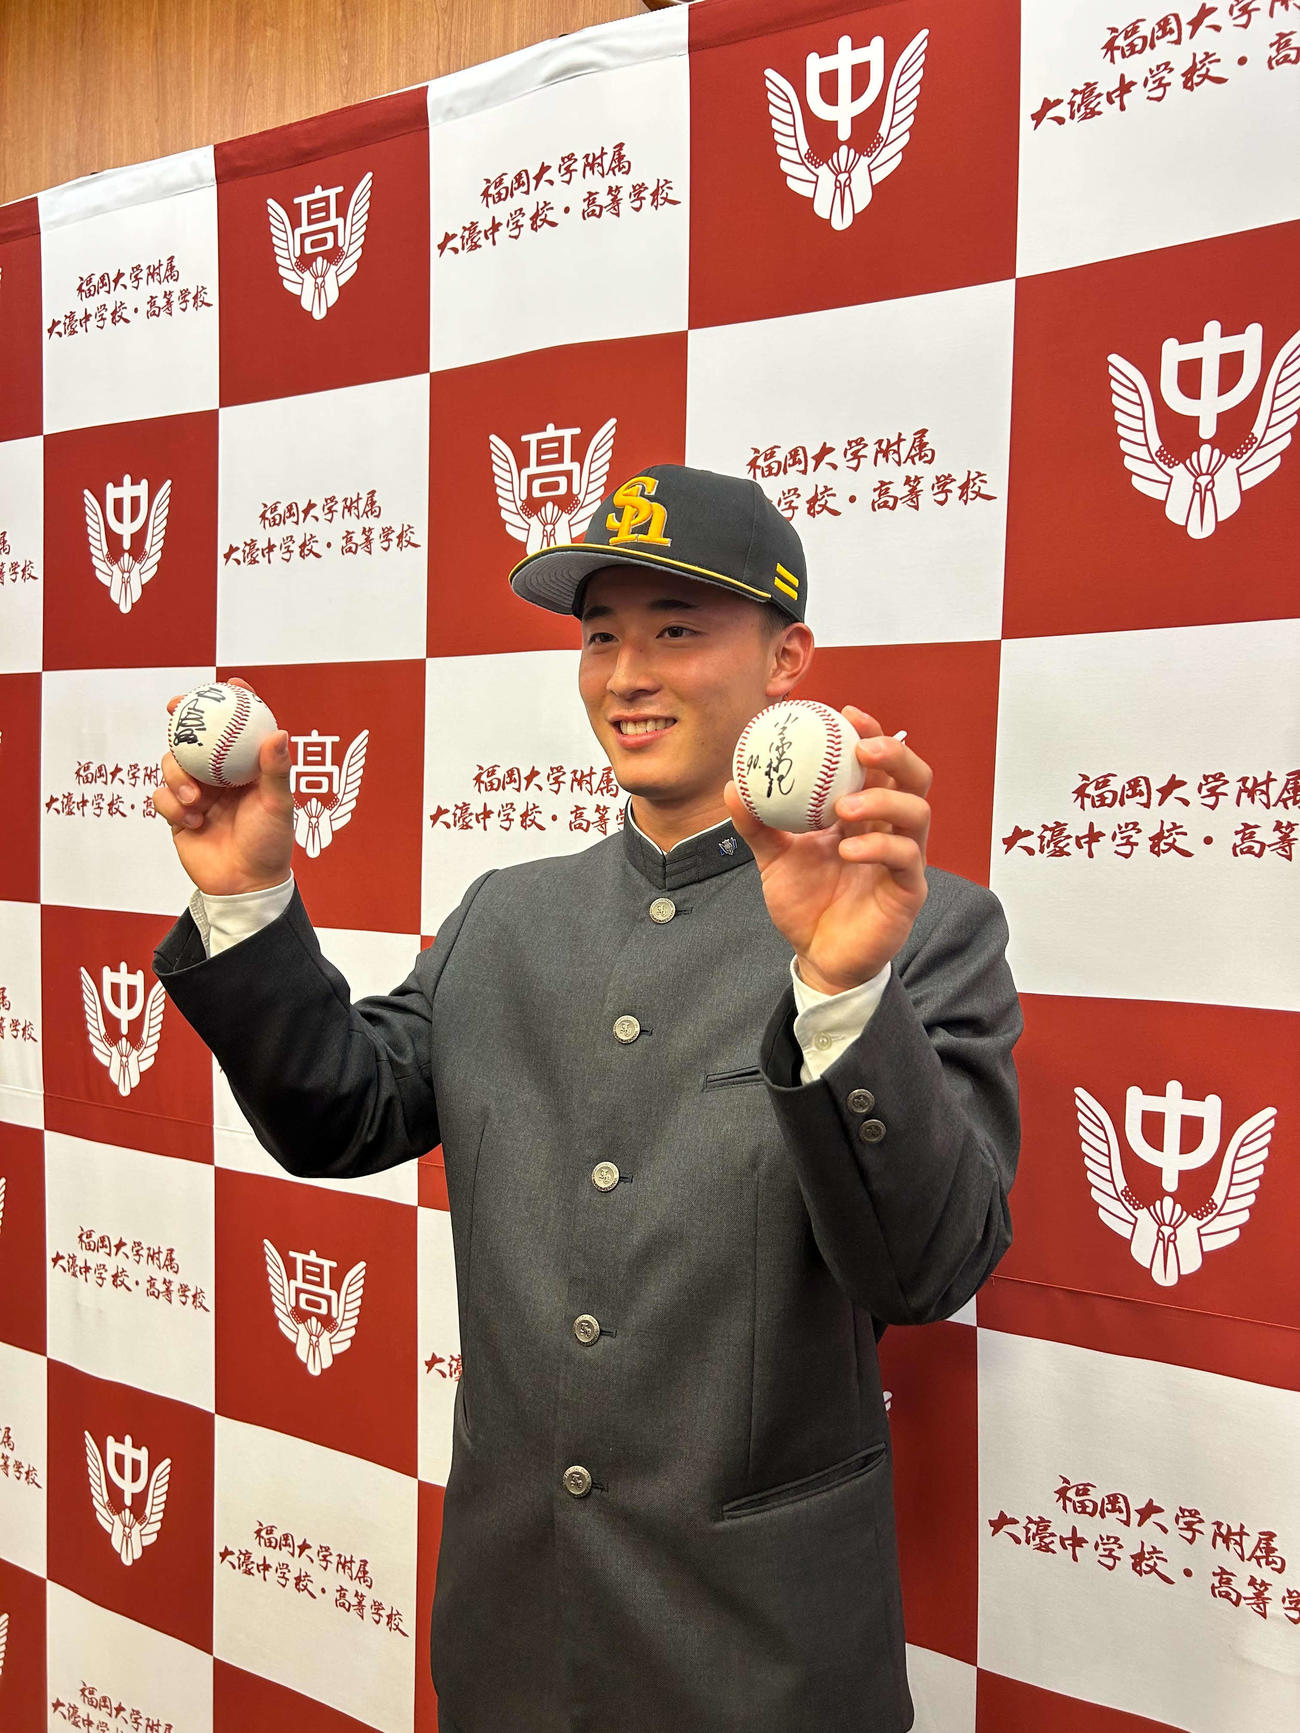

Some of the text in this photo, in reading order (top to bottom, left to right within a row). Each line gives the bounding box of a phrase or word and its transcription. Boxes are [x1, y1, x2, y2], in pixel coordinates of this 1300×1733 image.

[480, 142, 632, 208] 福岡大学附属
[437, 178, 682, 257] 大濠中学校・高等学校
[76, 255, 180, 301] 福岡大学附属
[47, 285, 213, 340] 大濠中学校・高等学校
[746, 428, 936, 480] 福岡大学附属
[259, 489, 382, 530] 福岡大学附属
[768, 470, 997, 522] 学校・高等学校
[223, 522, 422, 567] 大濠中学校・高等学校
[74, 760, 168, 788] 福岡大学附
[472, 764, 620, 797] 福岡大学附属
[1002, 819, 1300, 862] 大濠中学校・高等
[76, 1226, 180, 1276] 福岡大学附属
[50, 1249, 211, 1313] 大濠中学校・高等学校
[1054, 1475, 1286, 1575] 福岡大学附属
[254, 1520, 373, 1591] 福岡大学附属
[219, 1545, 409, 1638] 大濠中学校・高等学校
[52, 1697, 123, 1733] 大濠中学
